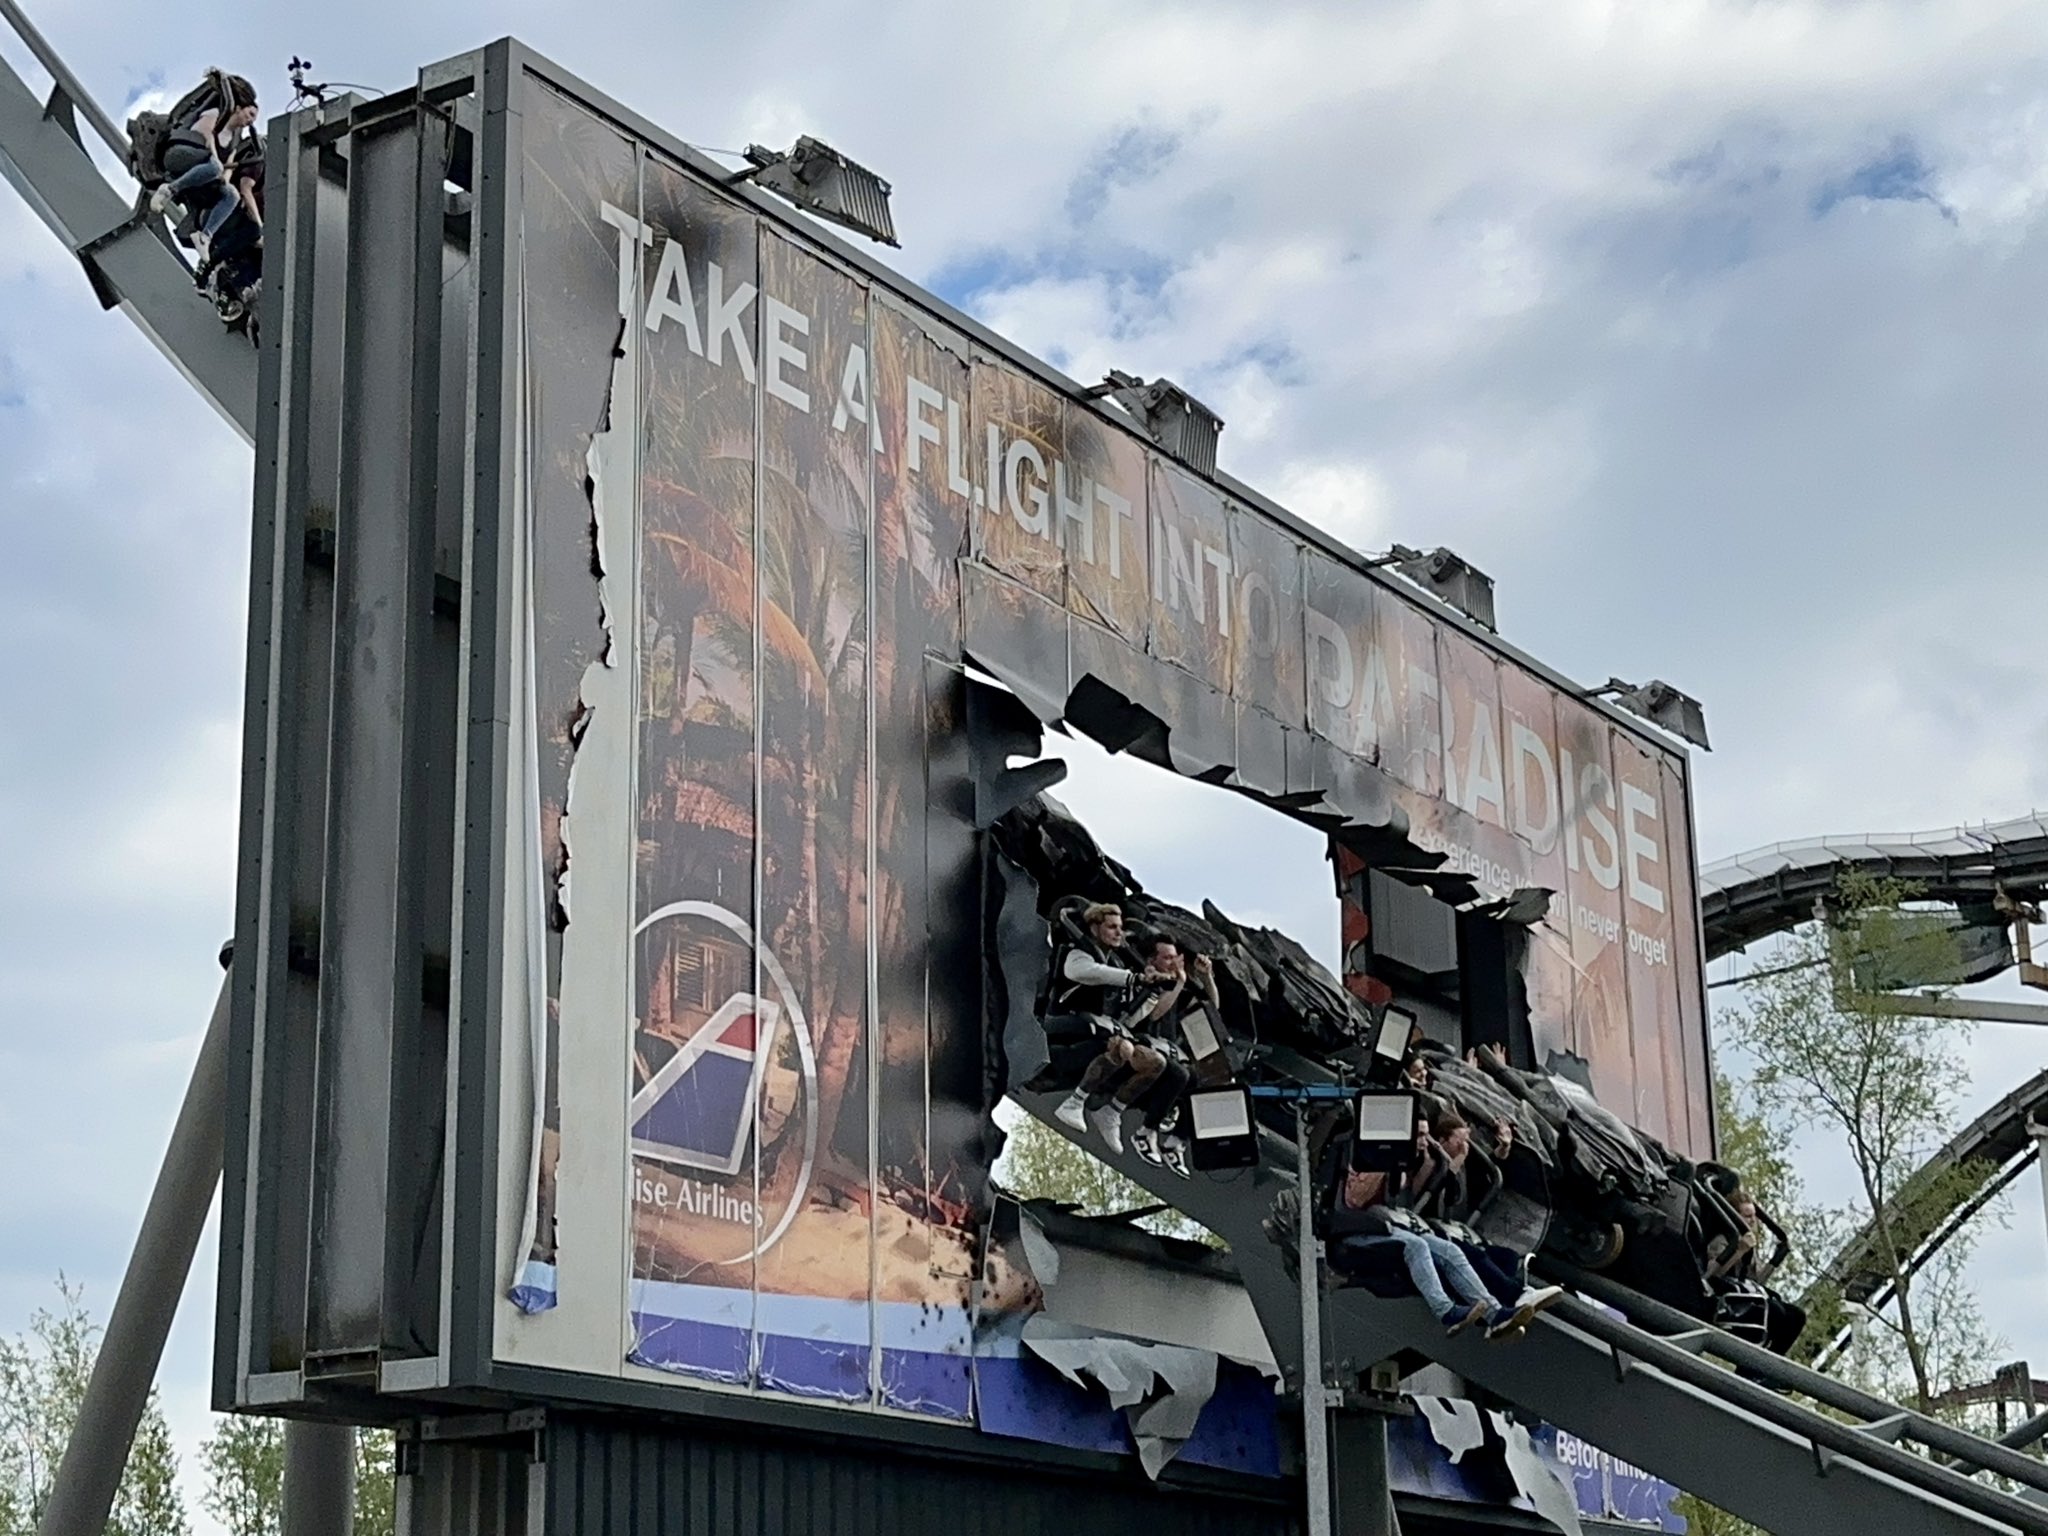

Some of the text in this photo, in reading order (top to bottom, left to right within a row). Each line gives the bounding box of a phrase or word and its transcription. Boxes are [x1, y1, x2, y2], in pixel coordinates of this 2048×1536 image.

[601, 200, 1665, 914] TAKE A FLIGHT INTO PARADISE
[1578, 905, 1620, 944] never
[1625, 922, 1668, 967] orget
[631, 1167, 763, 1228] ise Airlines
